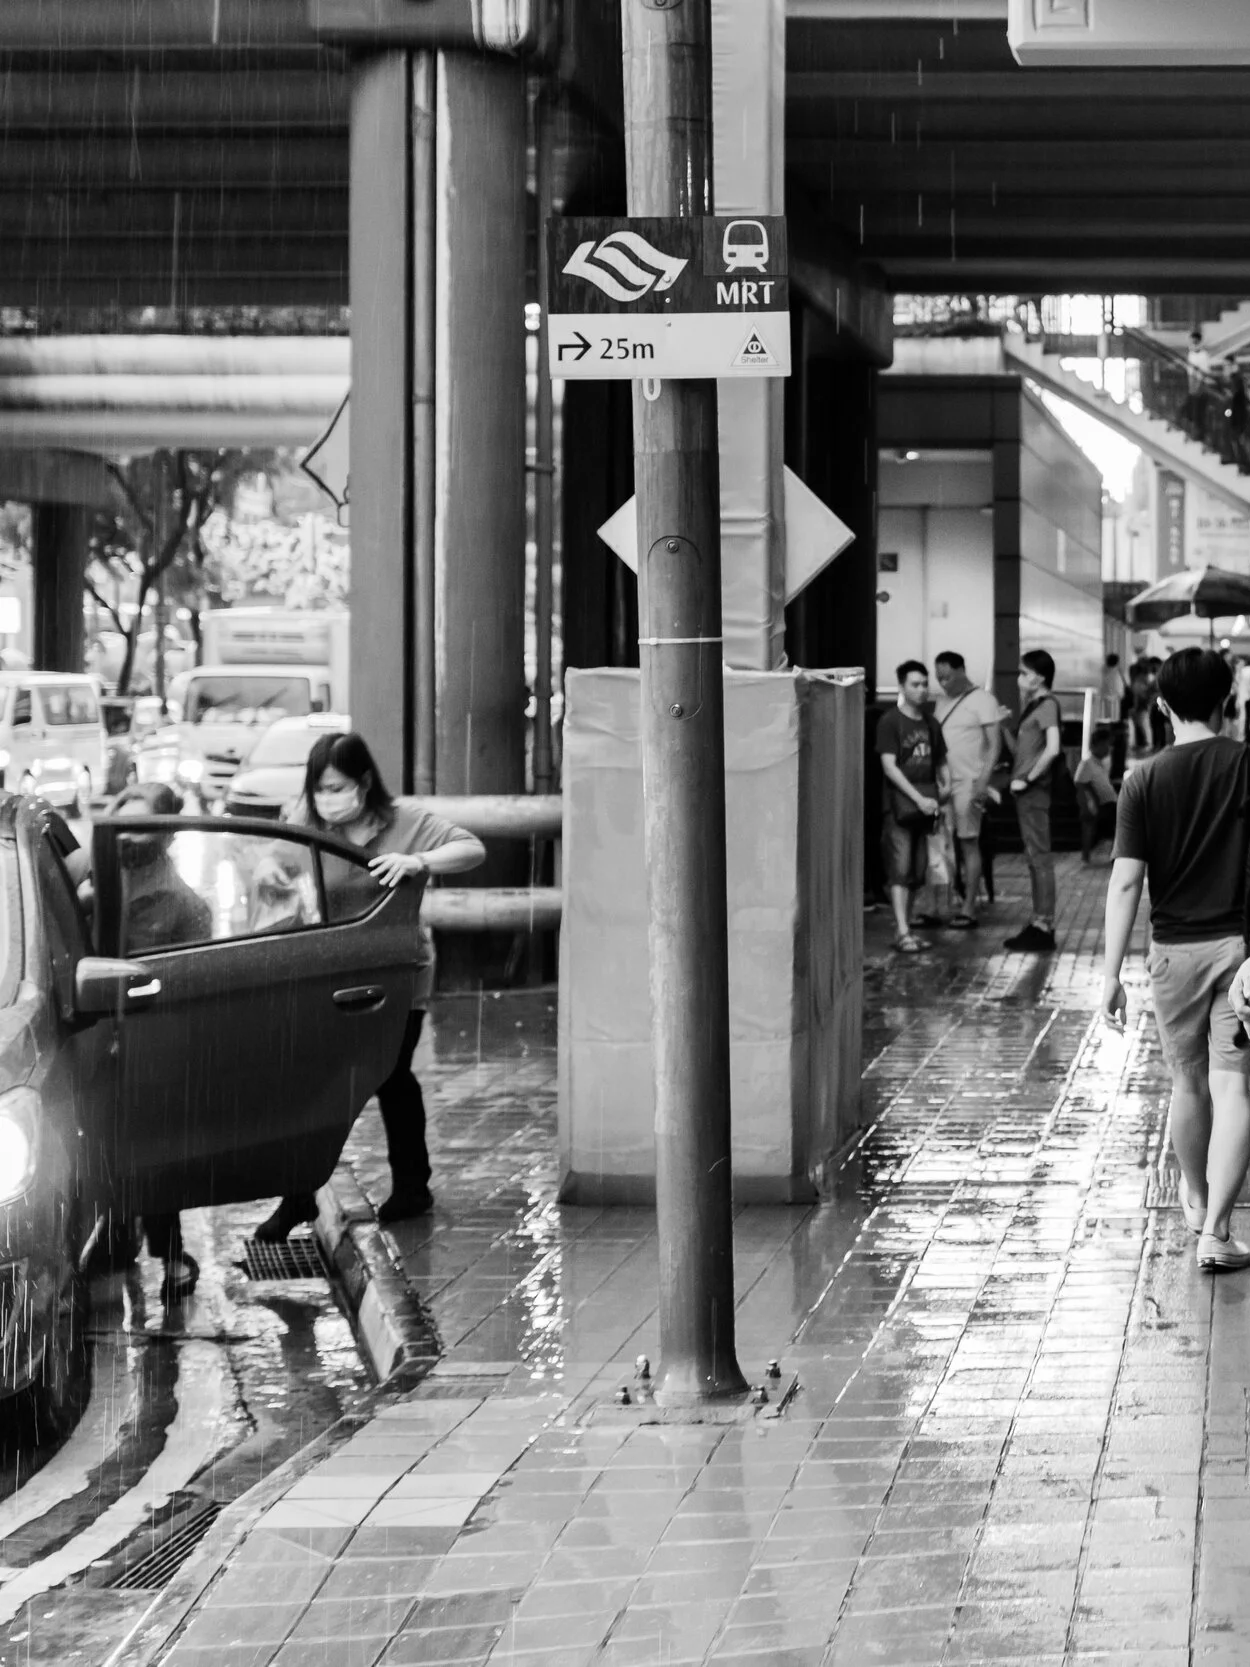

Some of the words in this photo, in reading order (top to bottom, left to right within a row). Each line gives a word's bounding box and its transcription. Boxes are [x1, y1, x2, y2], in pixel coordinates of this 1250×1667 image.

[717, 281, 775, 305] MRT
[600, 338, 654, 359] 25m
[741, 355, 768, 364] Shelter
